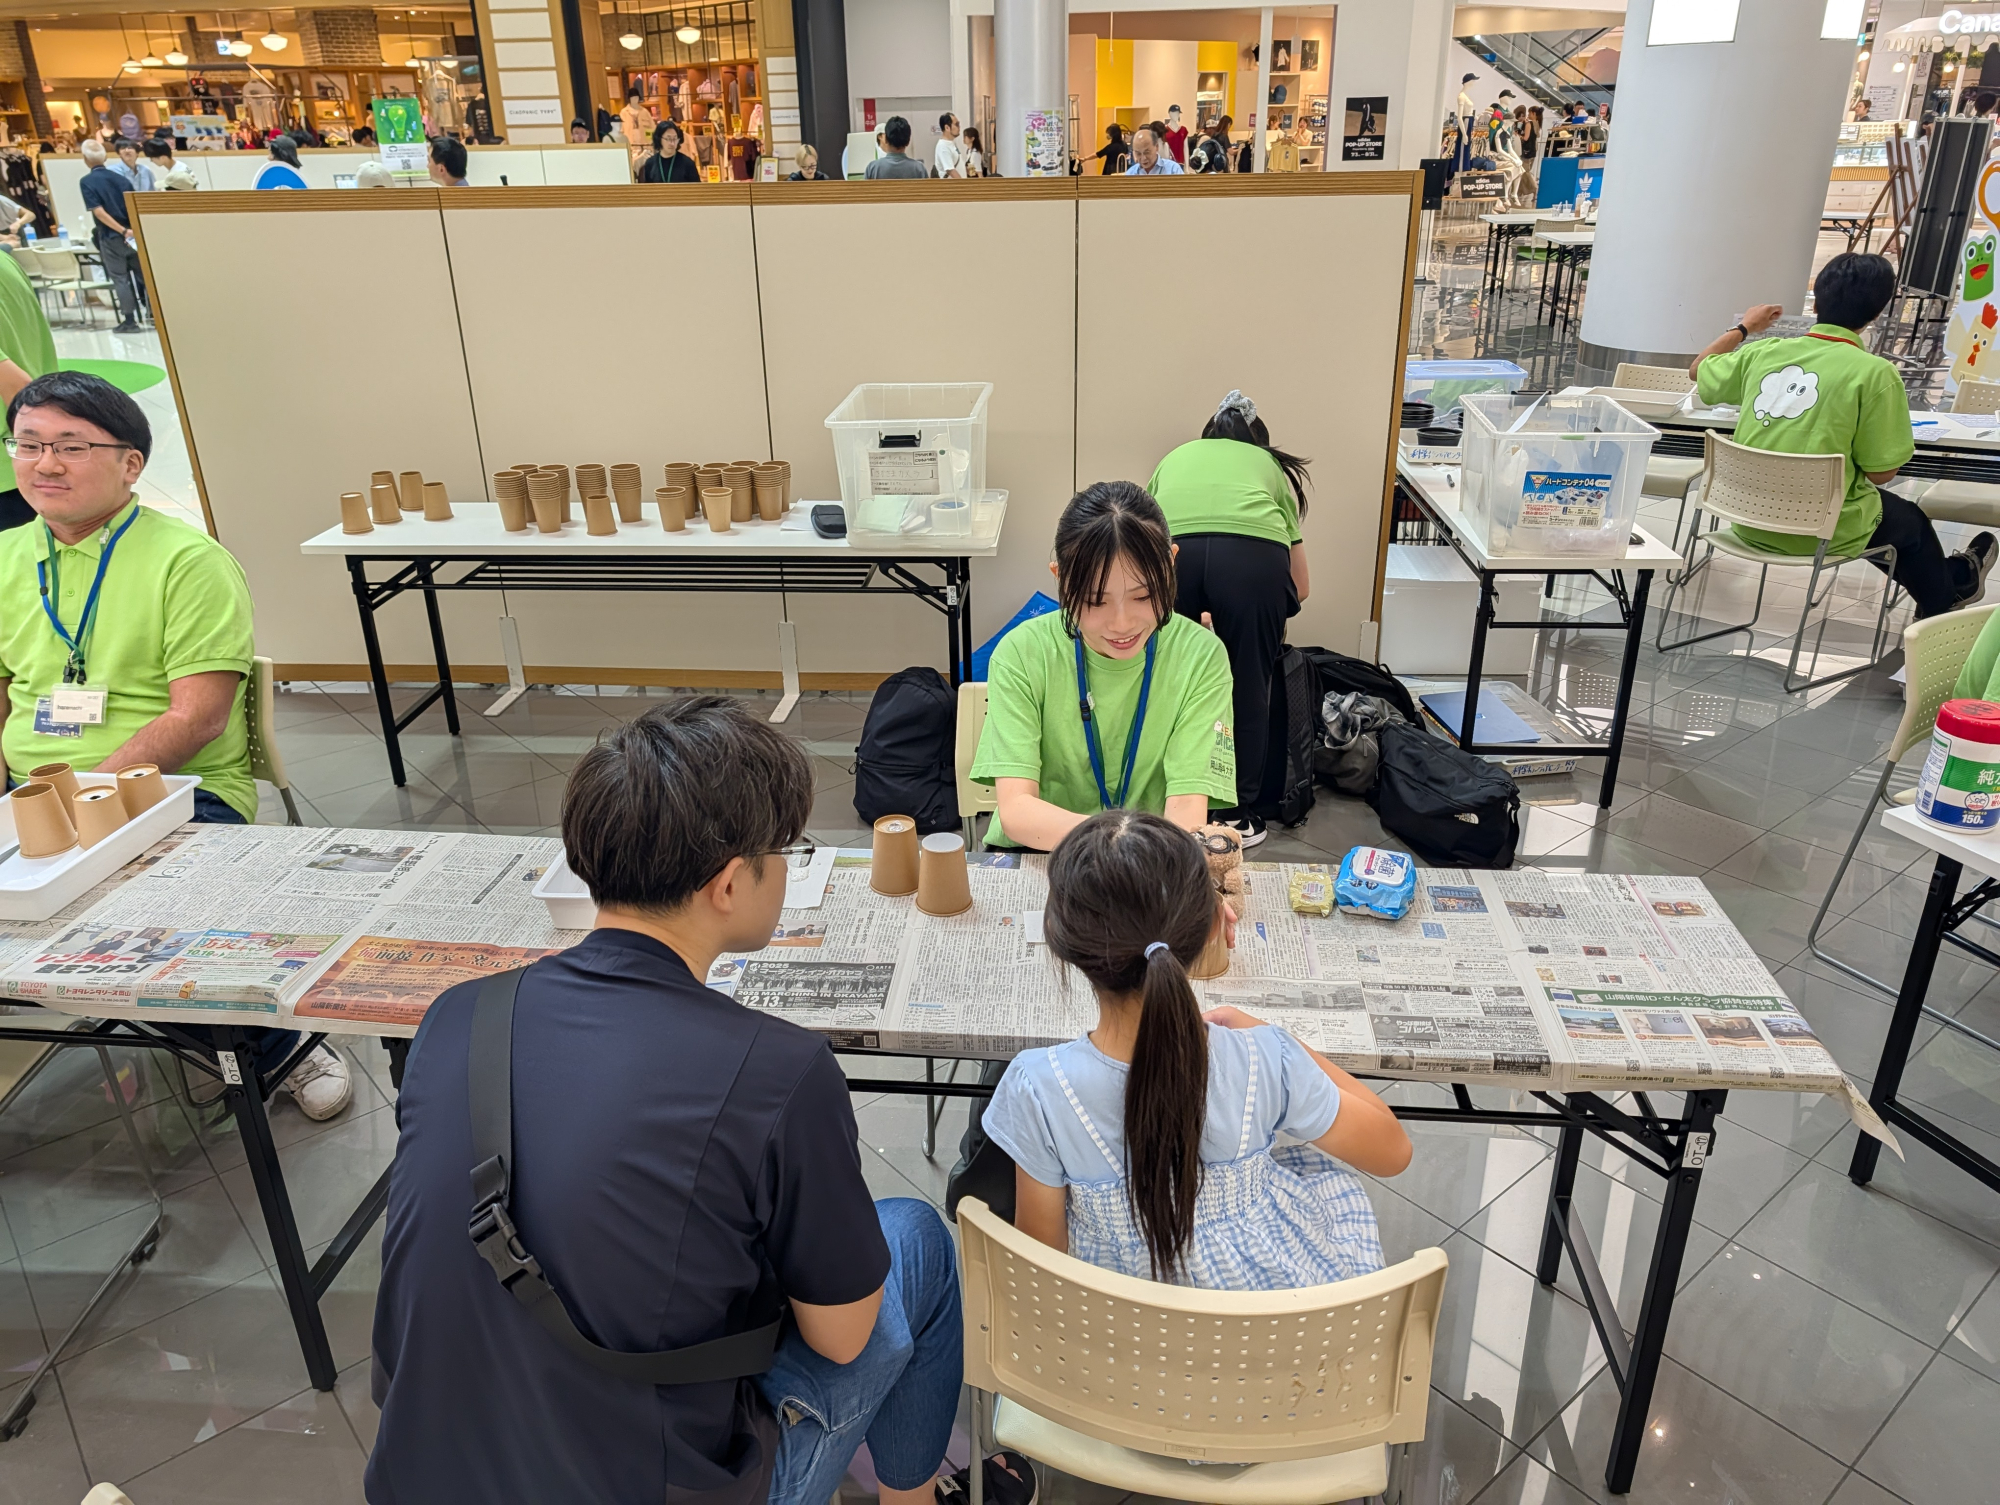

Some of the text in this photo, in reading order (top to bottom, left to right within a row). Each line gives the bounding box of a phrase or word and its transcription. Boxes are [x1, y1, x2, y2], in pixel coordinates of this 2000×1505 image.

[1485, 182, 1503, 190] STORE
[1545, 478, 1595, 487] ハードコンテナ04
[759, 968, 864, 977] マーチング・イン・オカヤマ
[20, 981, 48, 989] TOYOTA
[65, 988, 132, 997] トヨタレンタリース岡山
[1603, 993, 1775, 1007] 山陽新聞ID・さん太クラブ協賛店特集
[310, 1001, 348, 1012] 山陽新聞社
[1399, 1025, 1434, 1034] コバック
